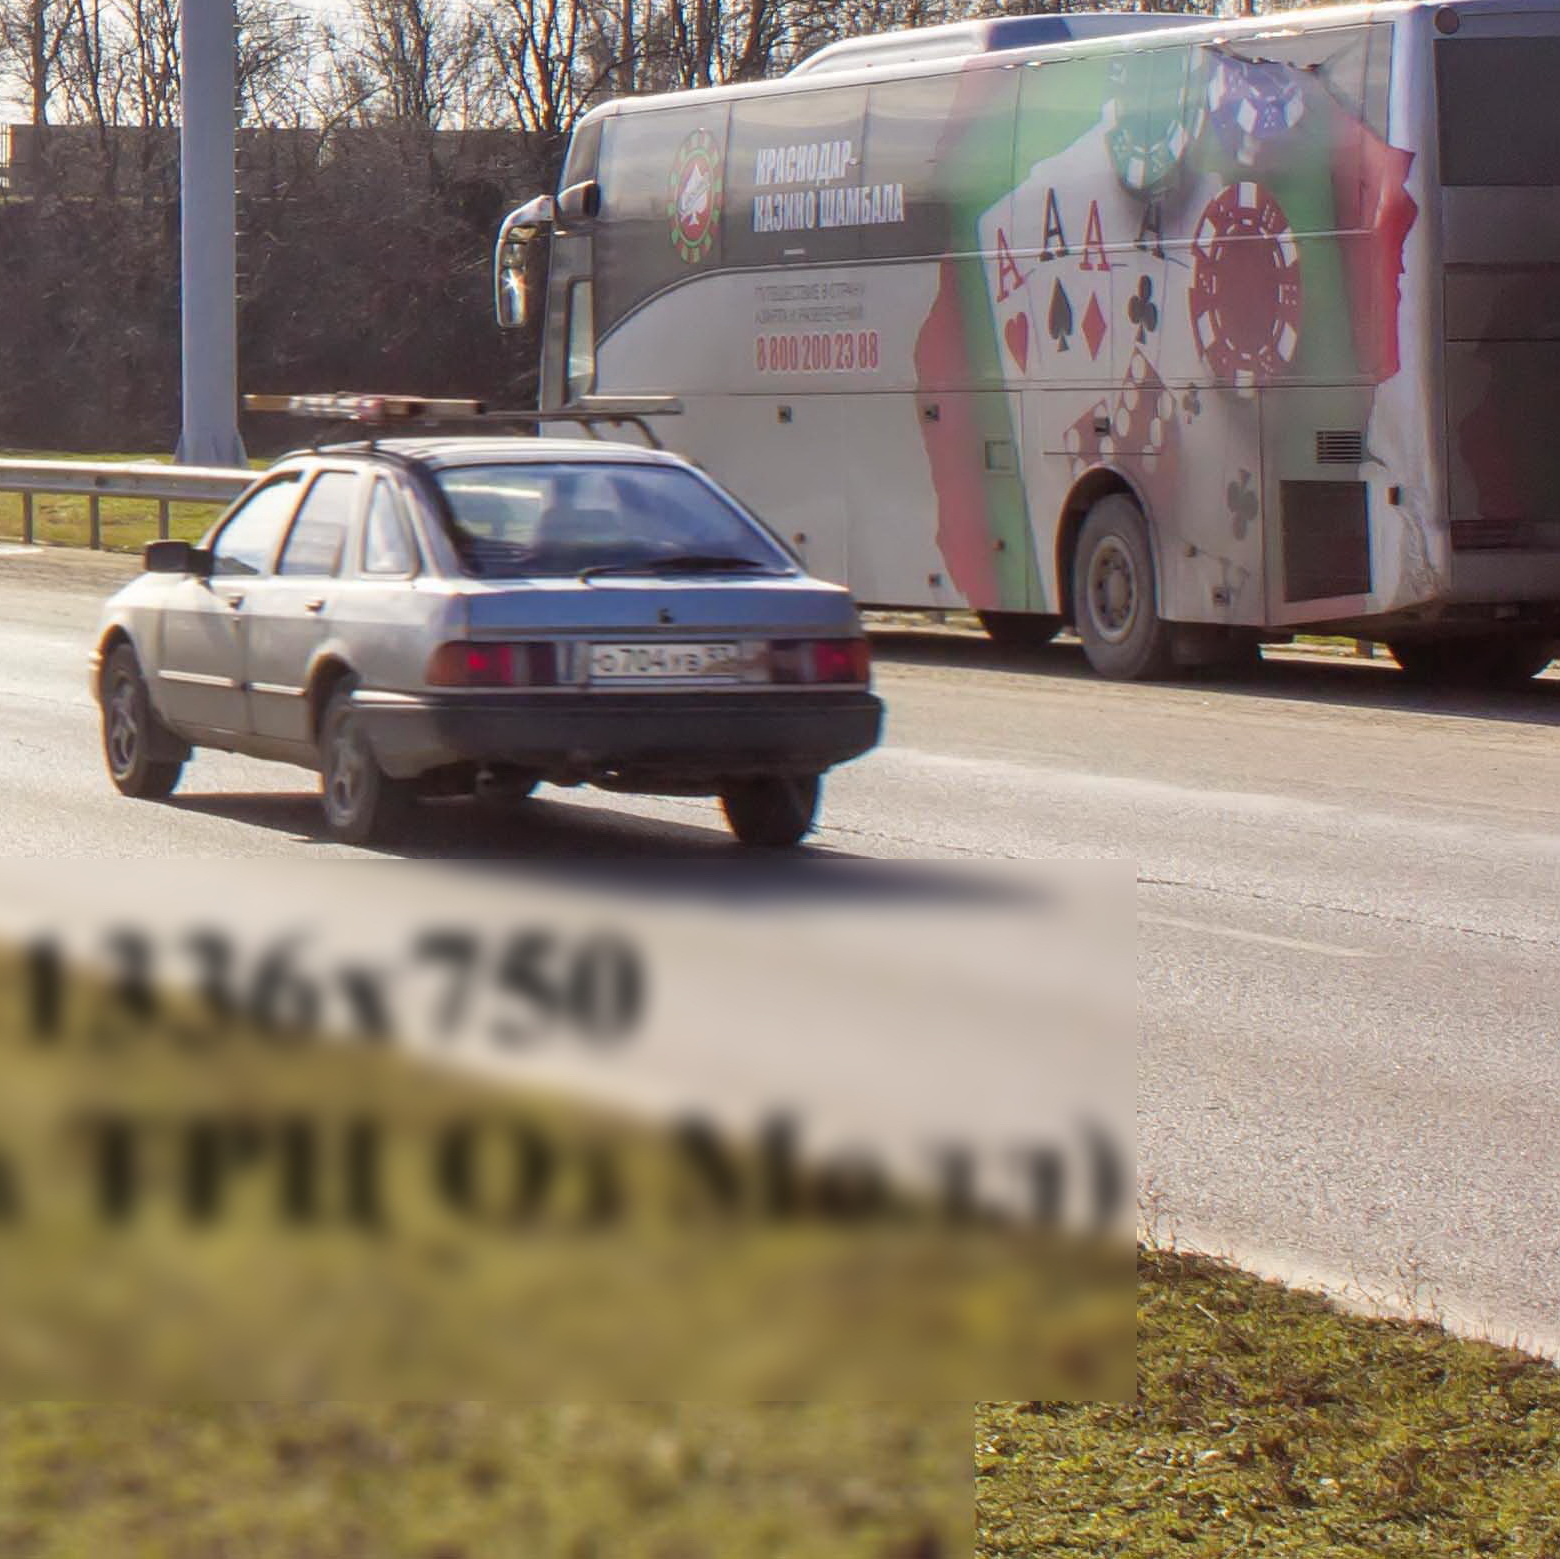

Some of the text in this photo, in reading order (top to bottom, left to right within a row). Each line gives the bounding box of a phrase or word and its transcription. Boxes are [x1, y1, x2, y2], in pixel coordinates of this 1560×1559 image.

[753, 183, 906, 233] КАЗИНО ШАМБАЛА
[757, 337, 767, 372] 8
[769, 335, 798, 371] 800
[802, 334, 832, 371] 200
[834, 332, 854, 370] 23
